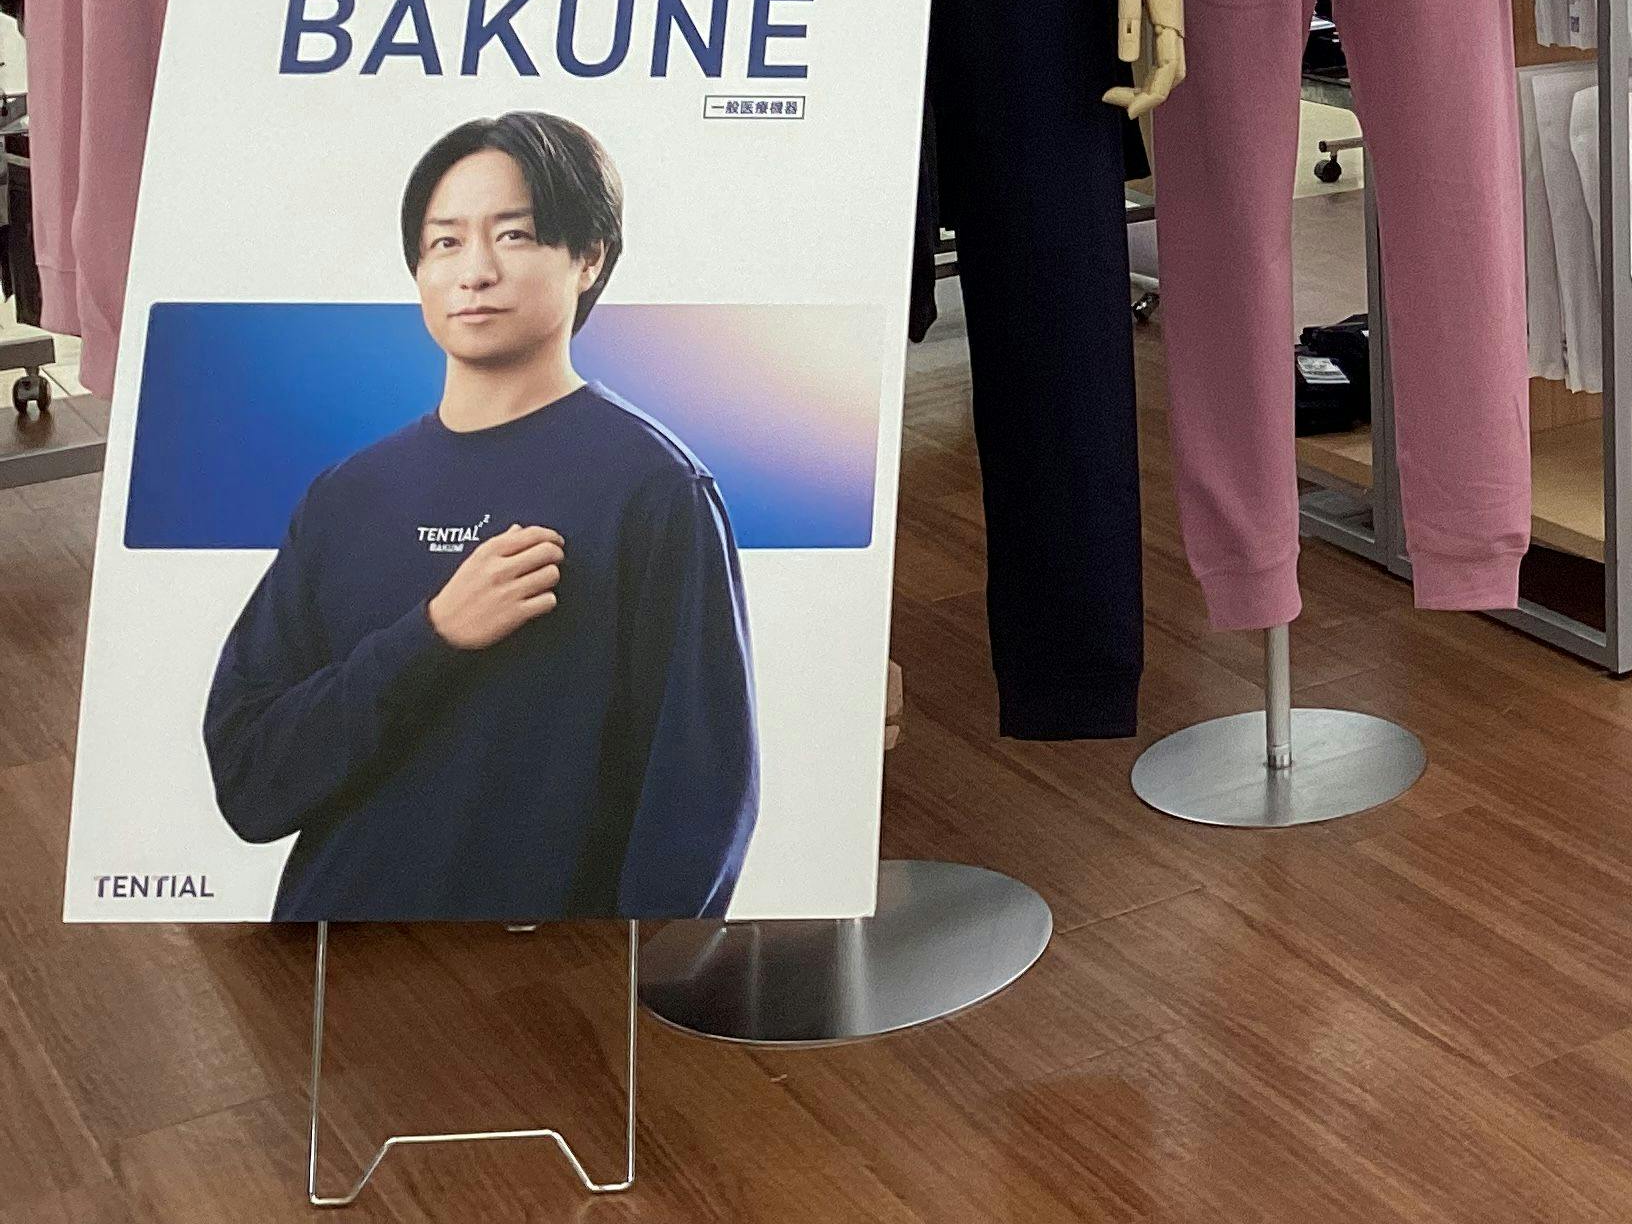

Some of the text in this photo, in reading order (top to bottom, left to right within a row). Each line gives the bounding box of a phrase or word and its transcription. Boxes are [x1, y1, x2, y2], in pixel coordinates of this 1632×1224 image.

[711, 101, 798, 115] 一般医療機器
[417, 525, 479, 542] TENTIAL
[95, 875, 214, 898] TENTIAL
